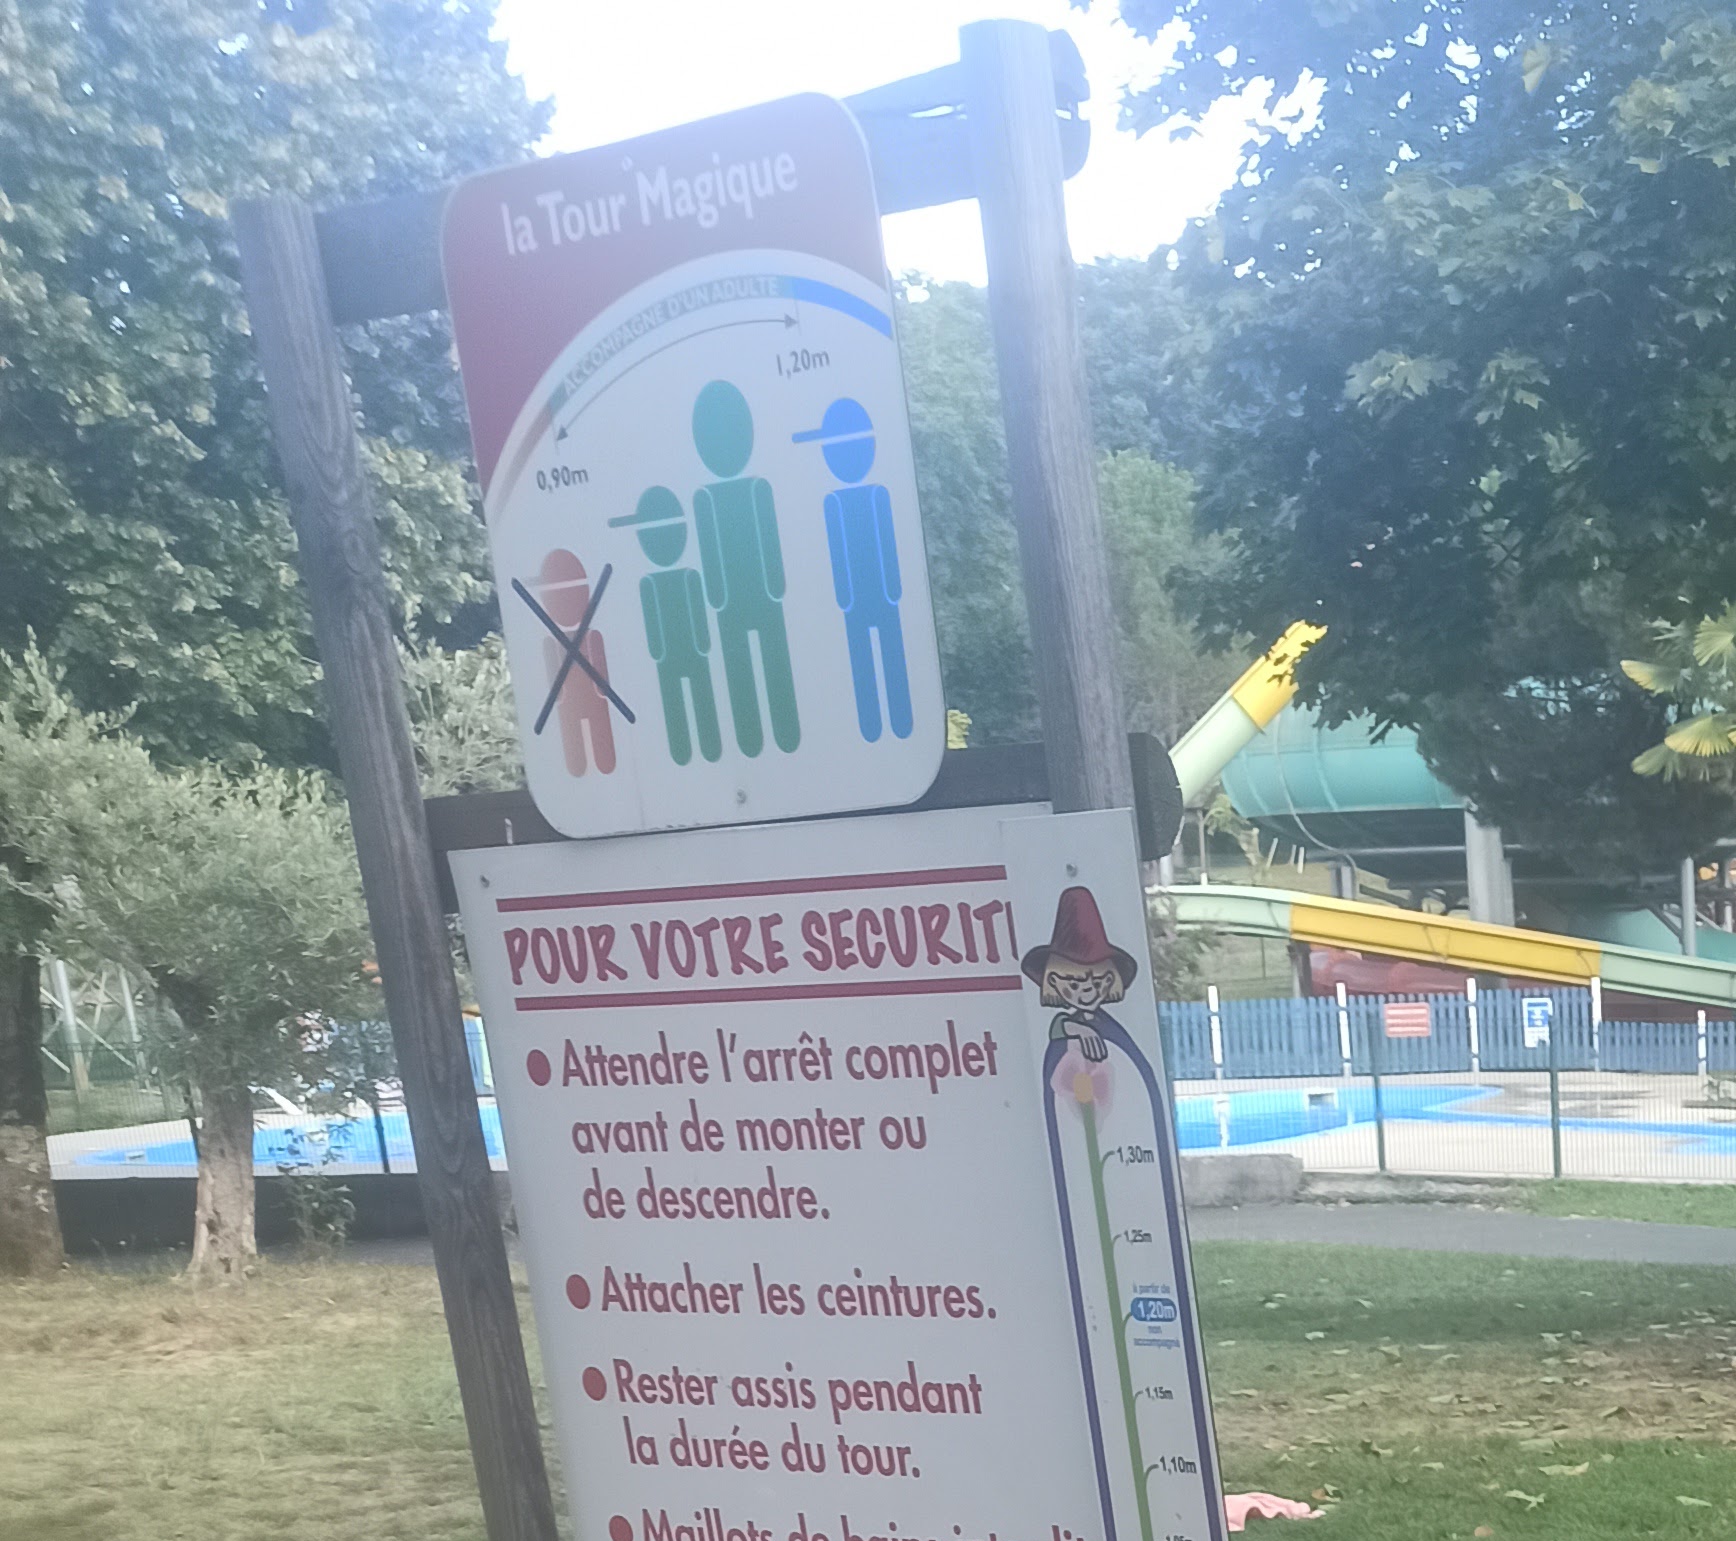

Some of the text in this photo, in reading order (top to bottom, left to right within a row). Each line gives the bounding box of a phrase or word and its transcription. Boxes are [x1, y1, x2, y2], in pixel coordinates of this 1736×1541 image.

[501, 152, 798, 255] la Tour Magique
[710, 276, 779, 302] ADULTE
[776, 348, 830, 379] 1,20m
[536, 466, 589, 494] 0,90m
[504, 921, 627, 985] POUR
[631, 912, 790, 979] VOTRE
[561, 1019, 999, 1094] Attendre l'arrêt complet
[572, 1100, 926, 1154] avant de monter ou
[1117, 1145, 1154, 1166] 1,30m
[582, 1166, 830, 1221] de descendre.
[601, 1262, 997, 1320] Attacher les ceintures.
[1137, 1300, 1175, 1321] 1,20m
[613, 1359, 983, 1424] Rester assis pendant
[623, 1416, 920, 1478] la durée du tour.
[1160, 1456, 1197, 1475] 1,10m
